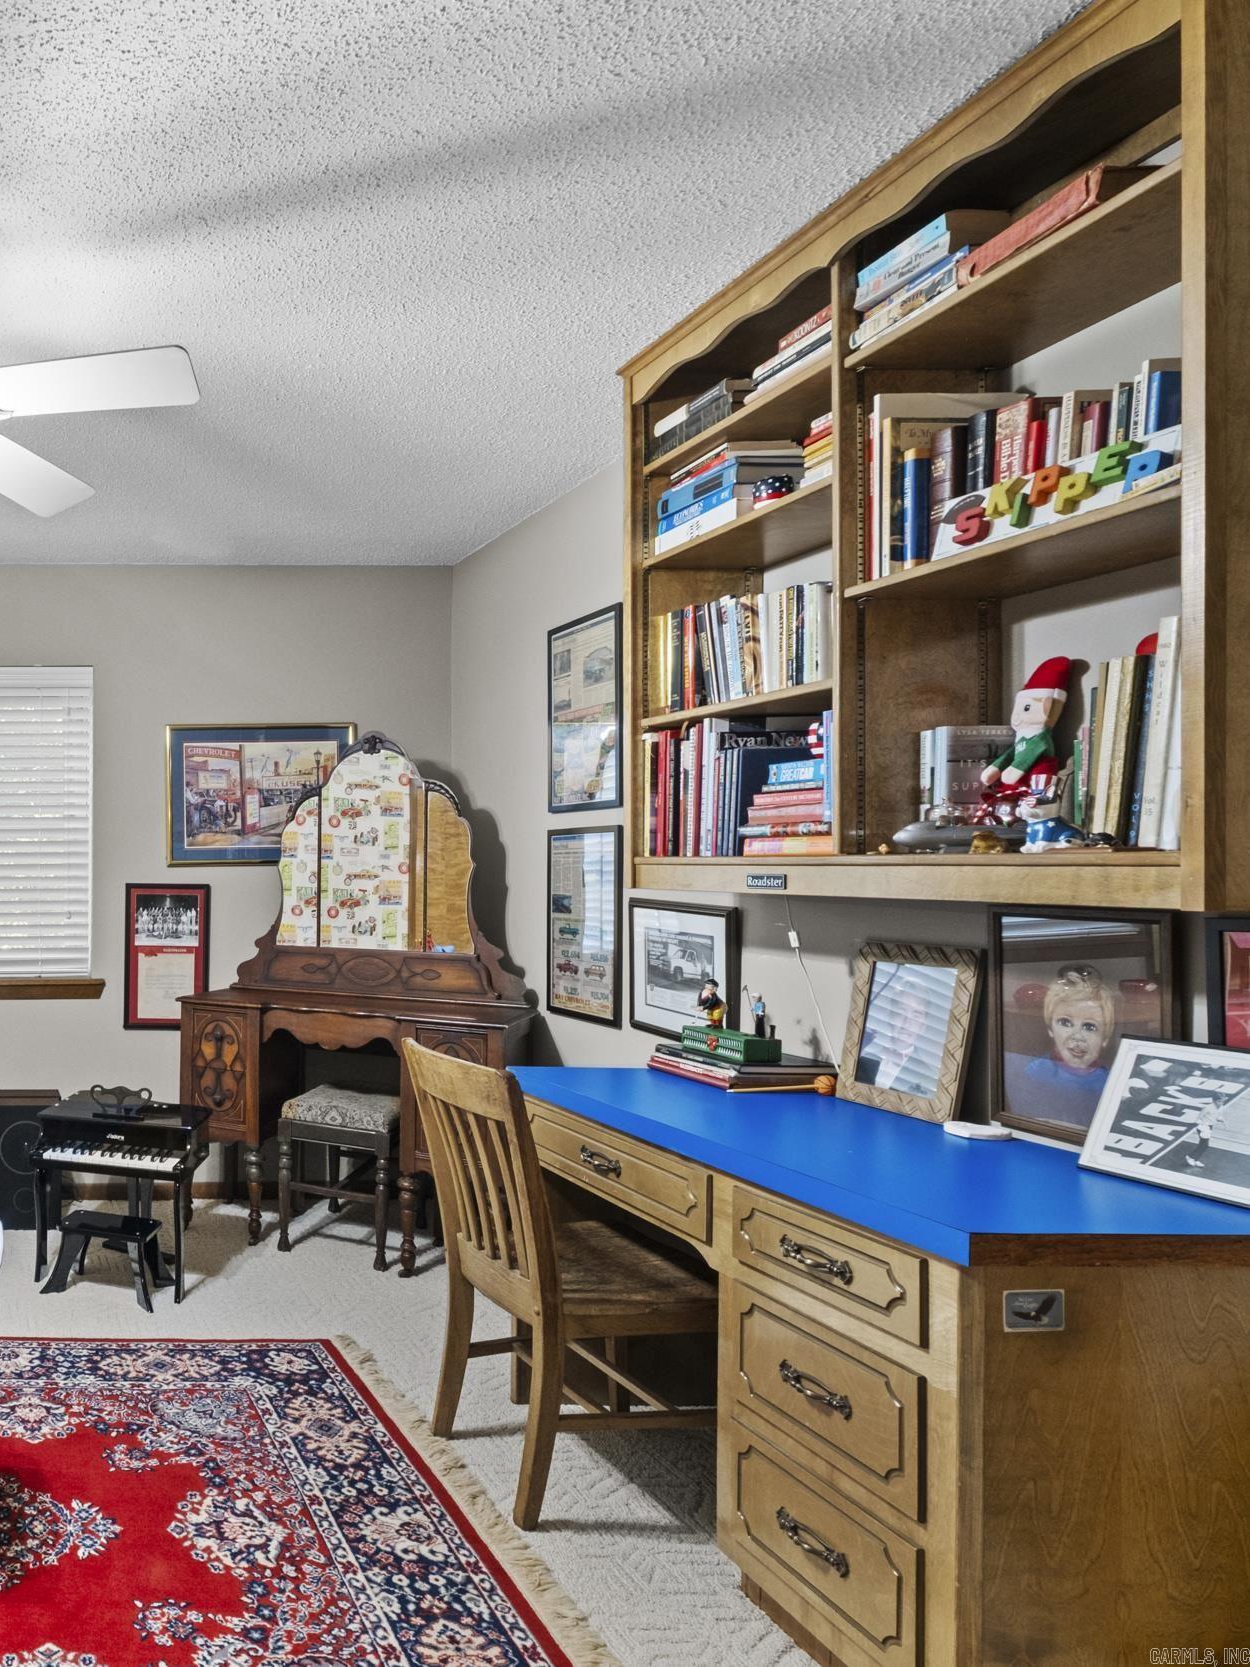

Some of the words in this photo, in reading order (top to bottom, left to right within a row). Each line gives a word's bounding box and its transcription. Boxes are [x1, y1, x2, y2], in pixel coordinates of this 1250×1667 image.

[1000, 438, 1012, 471] Bible
[723, 733, 767, 750] Ryan
[770, 731, 810, 748] New
[188, 747, 236, 759] CHEVROLET
[960, 759, 987, 768] IT'S
[951, 782, 978, 791] SUP
[746, 875, 783, 888] Roadster
